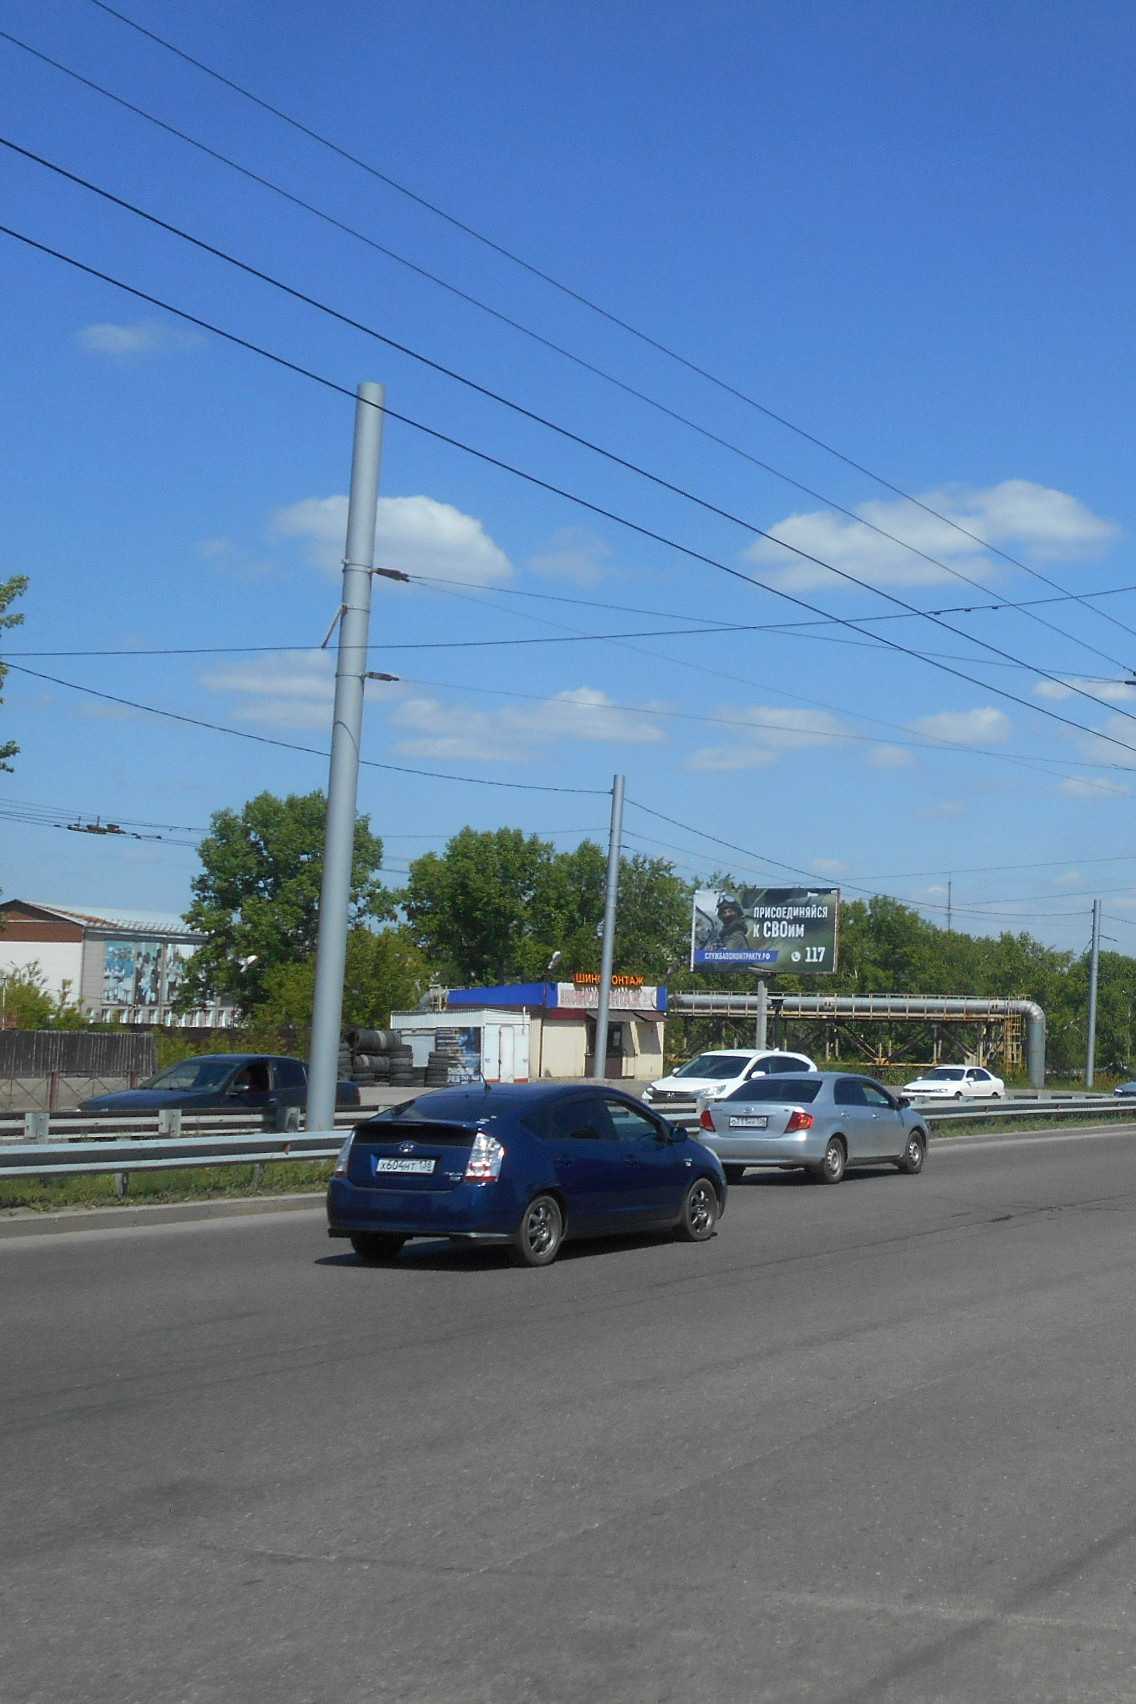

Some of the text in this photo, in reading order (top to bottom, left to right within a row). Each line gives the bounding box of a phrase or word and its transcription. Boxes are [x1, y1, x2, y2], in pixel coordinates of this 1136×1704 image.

[753, 904, 829, 920] ПРИСОЕДИНЯЙСЯ
[704, 952, 771, 961] СЛУЖБАПОКОНТРАКТУ.РФ
[805, 946, 826, 963] 117
[575, 973, 645, 986] ШИНООНТАЖ
